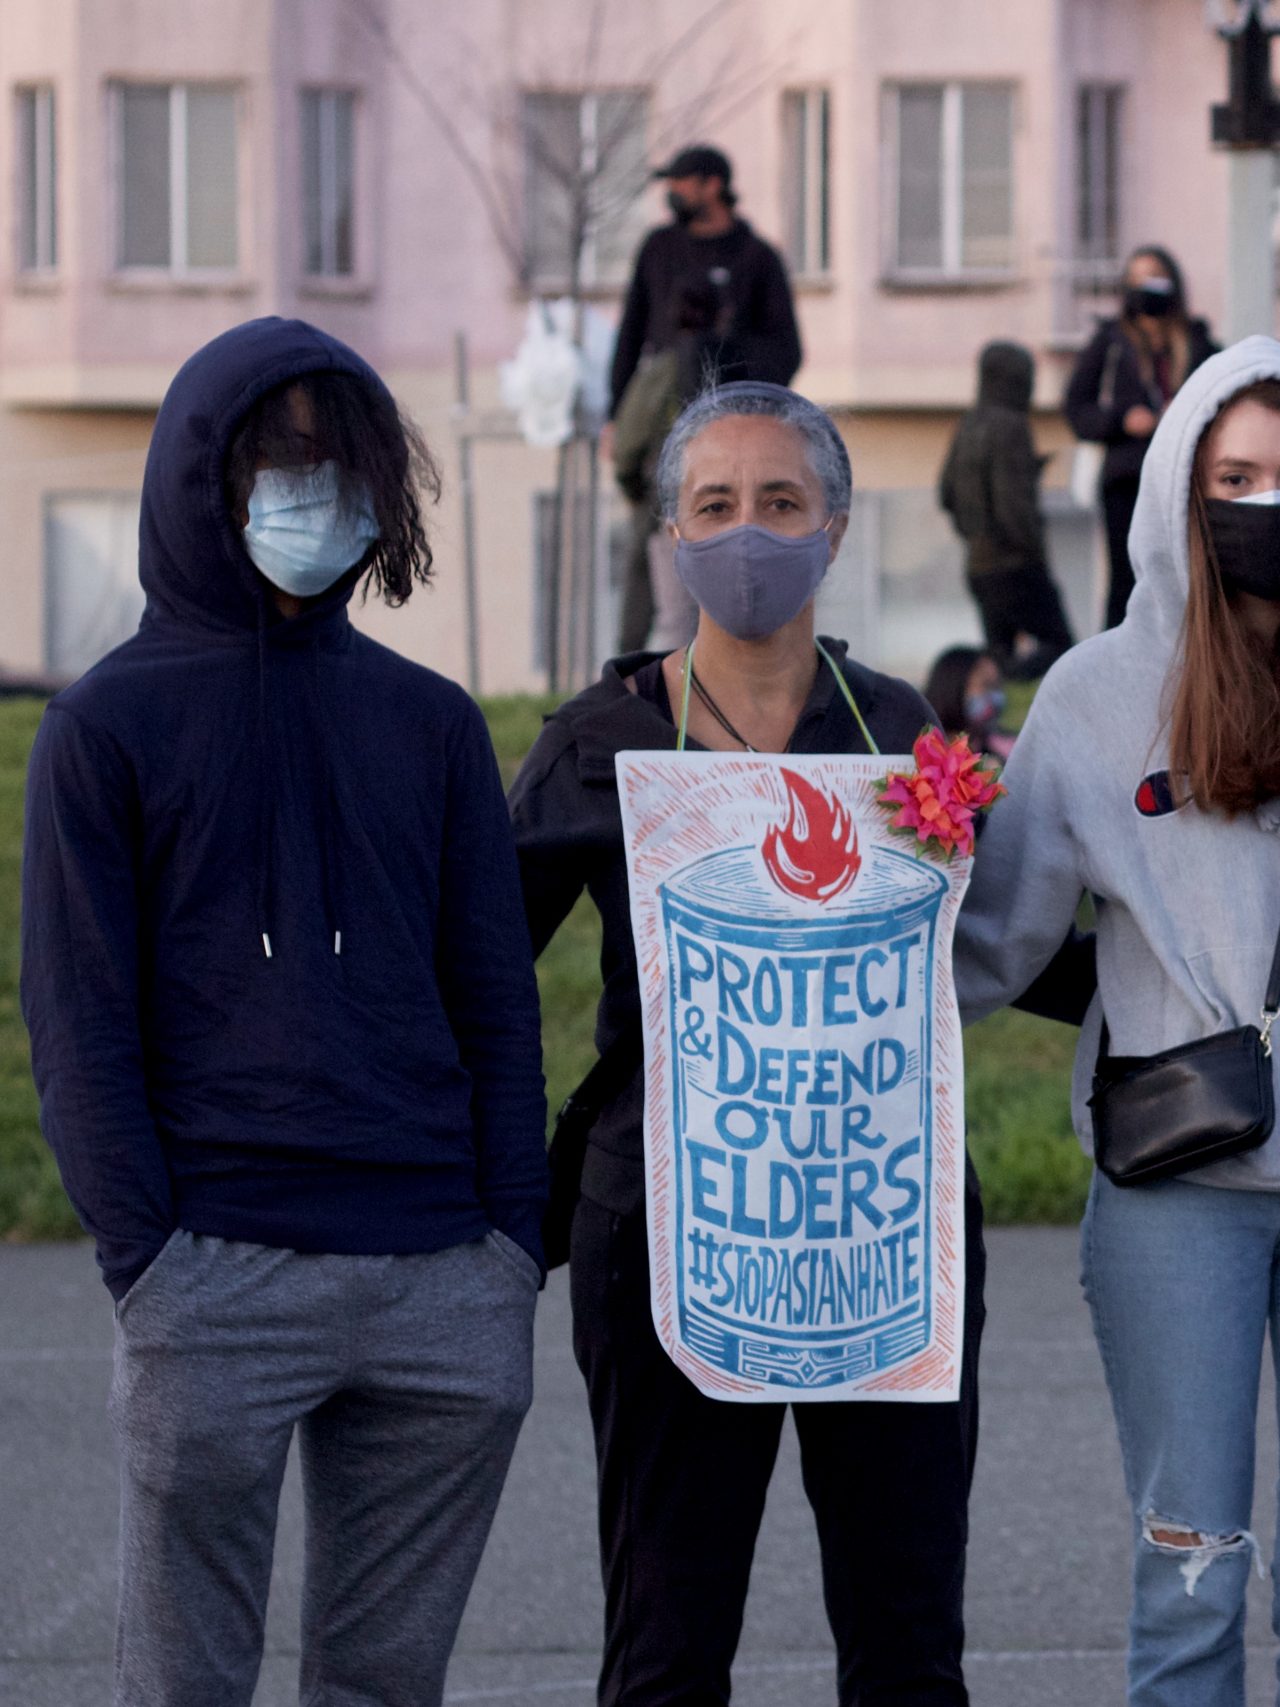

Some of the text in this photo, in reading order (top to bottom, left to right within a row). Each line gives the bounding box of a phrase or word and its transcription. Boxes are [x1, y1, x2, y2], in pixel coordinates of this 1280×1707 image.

[676, 932, 922, 1026] PROTECT
[679, 1006, 906, 1105] & DEFEND
[715, 1100, 886, 1158] OUR
[686, 1136, 922, 1239] ELDERS
[689, 1222, 920, 1325] #STOPASIANHATE
